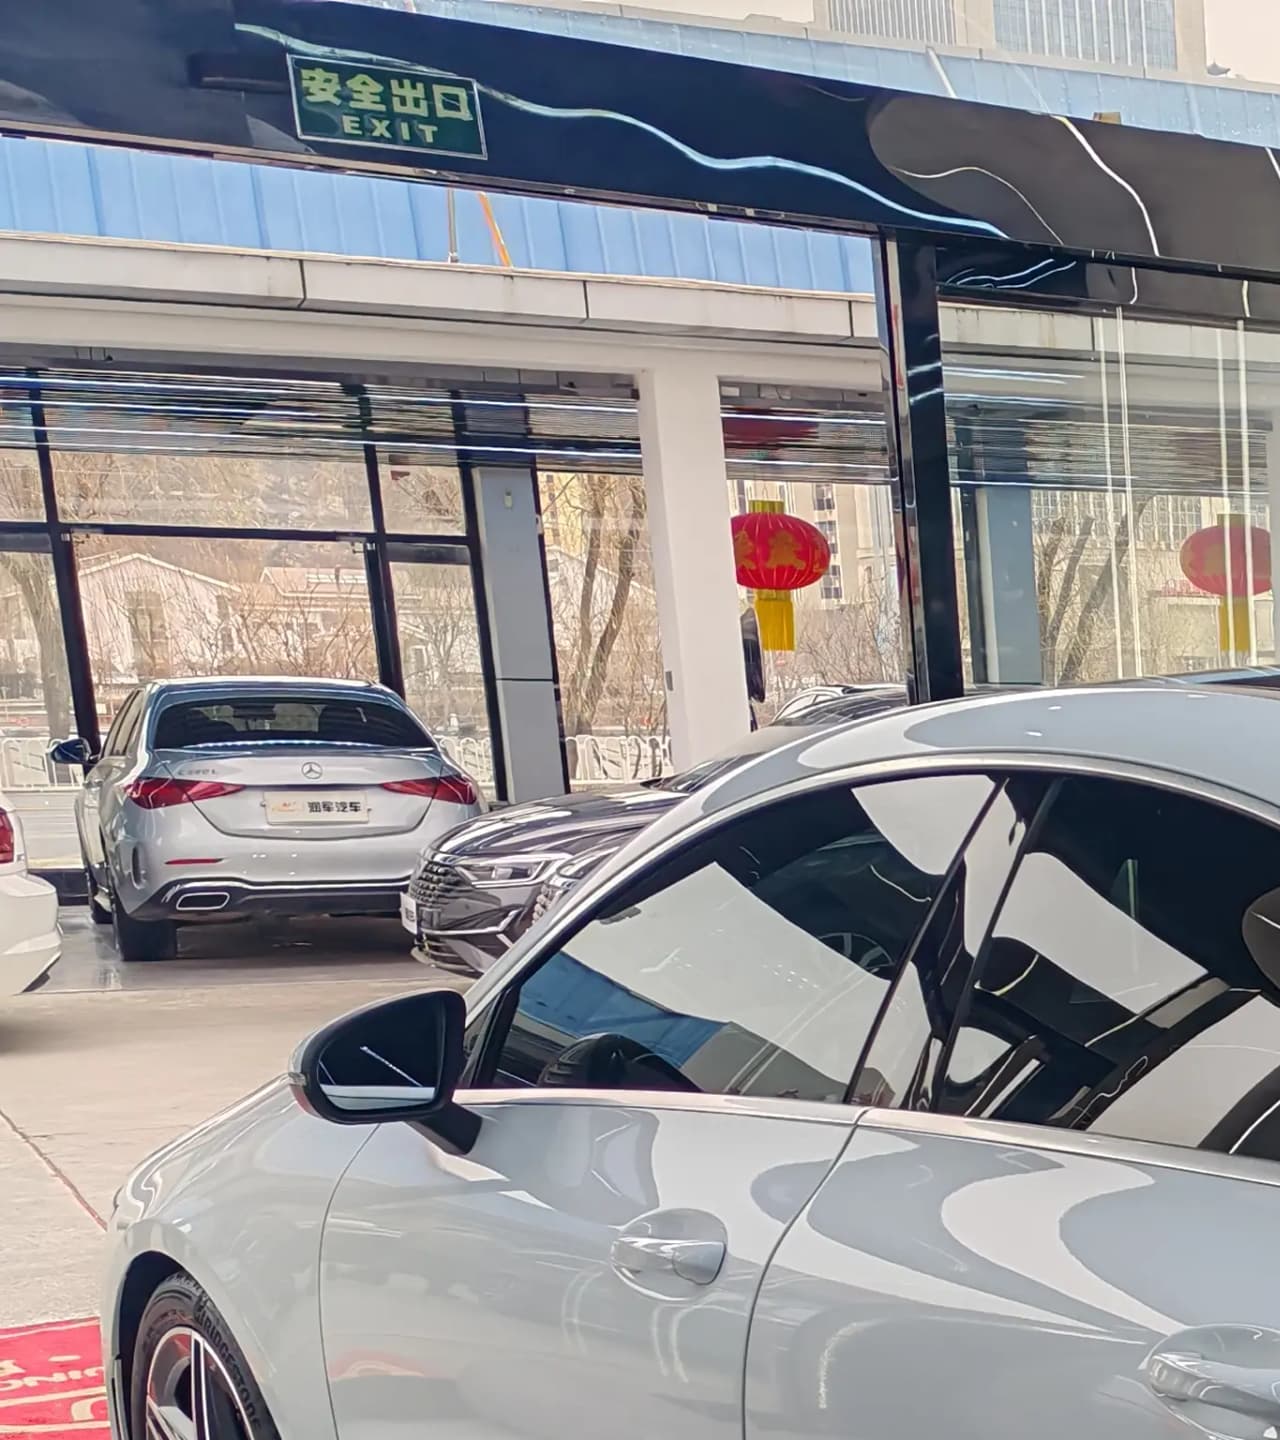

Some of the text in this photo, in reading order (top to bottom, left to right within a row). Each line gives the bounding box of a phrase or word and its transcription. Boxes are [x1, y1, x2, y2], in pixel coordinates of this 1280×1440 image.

[300, 67, 473, 121] 安全出口
[342, 114, 438, 143] EXIT
